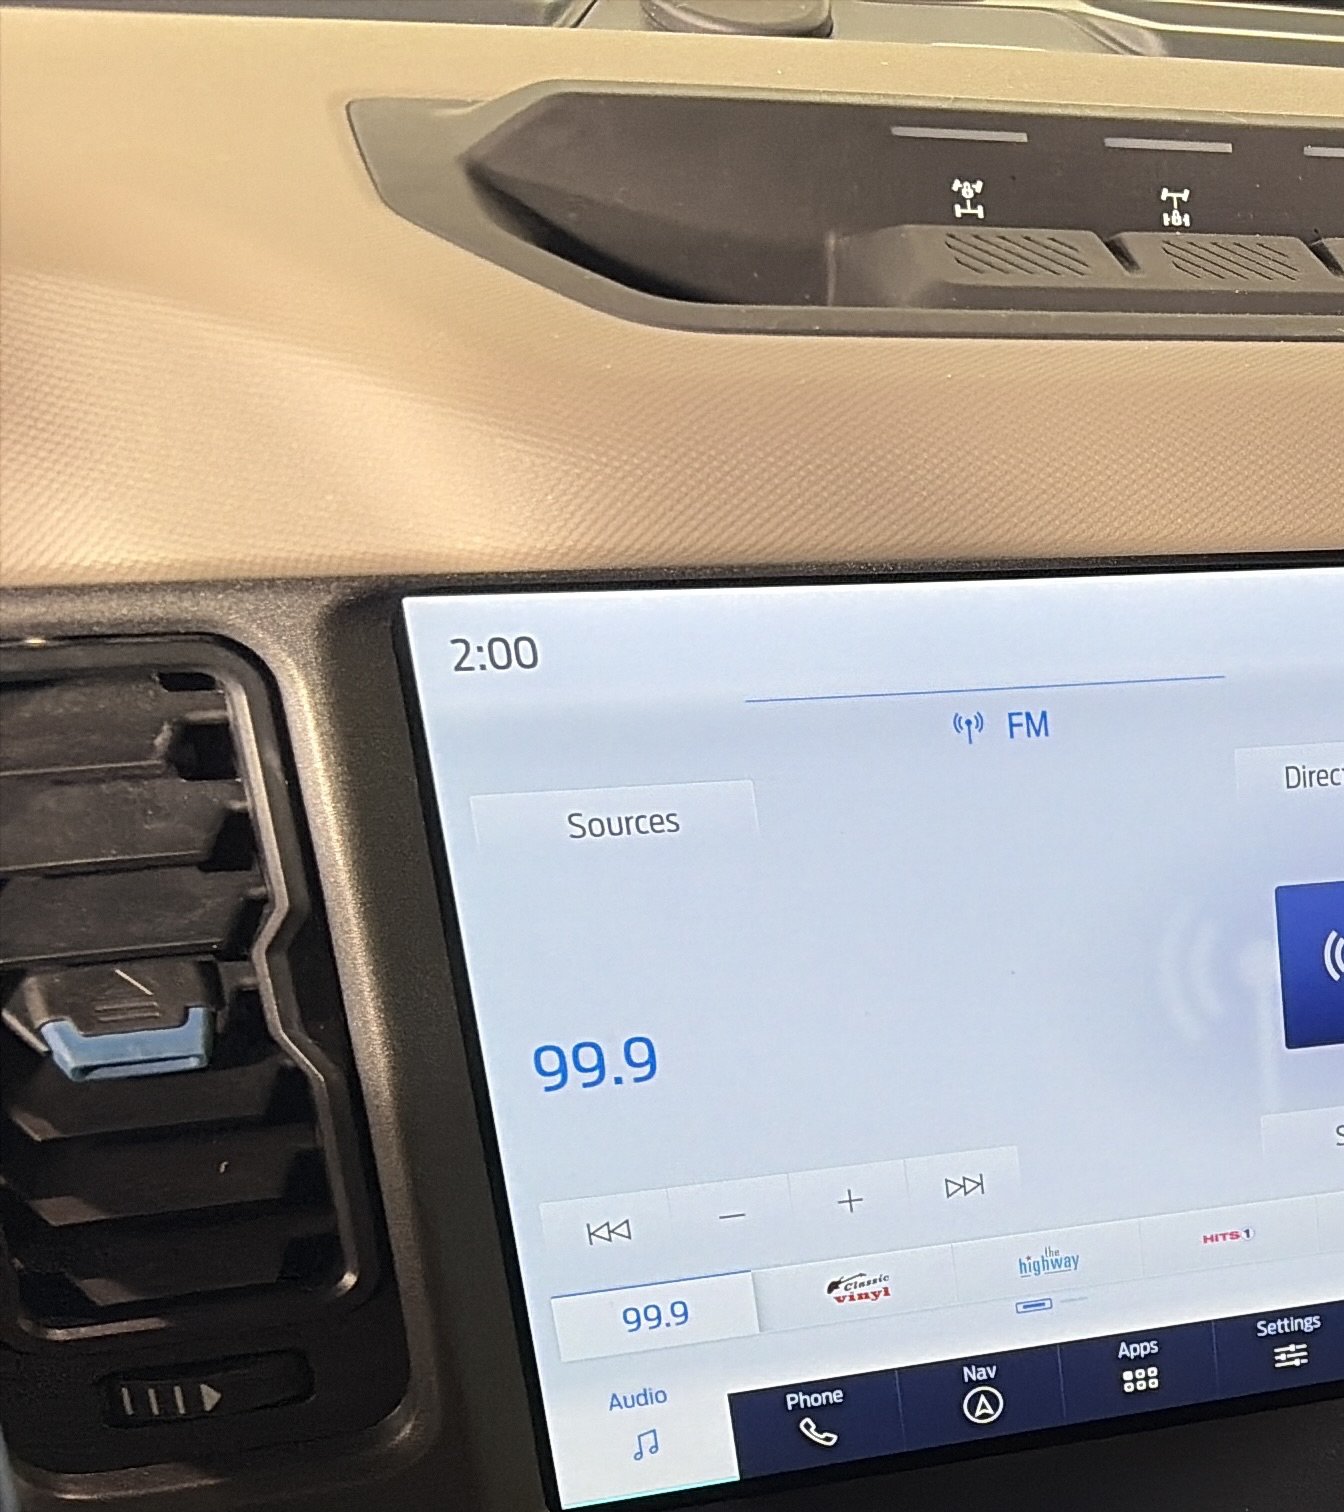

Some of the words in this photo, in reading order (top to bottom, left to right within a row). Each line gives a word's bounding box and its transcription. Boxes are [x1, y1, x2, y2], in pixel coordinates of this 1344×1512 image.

[450, 635, 539, 673] 2:00
[1007, 711, 1050, 740] FM
[567, 807, 680, 840] Sources
[533, 1035, 659, 1093] 99.9
[1018, 1251, 1080, 1279] highway
[1044, 1246, 1060, 1259] the
[832, 1286, 891, 1304] vinyl
[843, 1272, 890, 1292] Classic
[621, 1299, 690, 1334] 99.9
[1256, 1313, 1322, 1340] Settings
[1118, 1338, 1159, 1362] Apps
[962, 1363, 997, 1383] Nav
[608, 1385, 667, 1412] Audio
[785, 1385, 844, 1412] Phone
